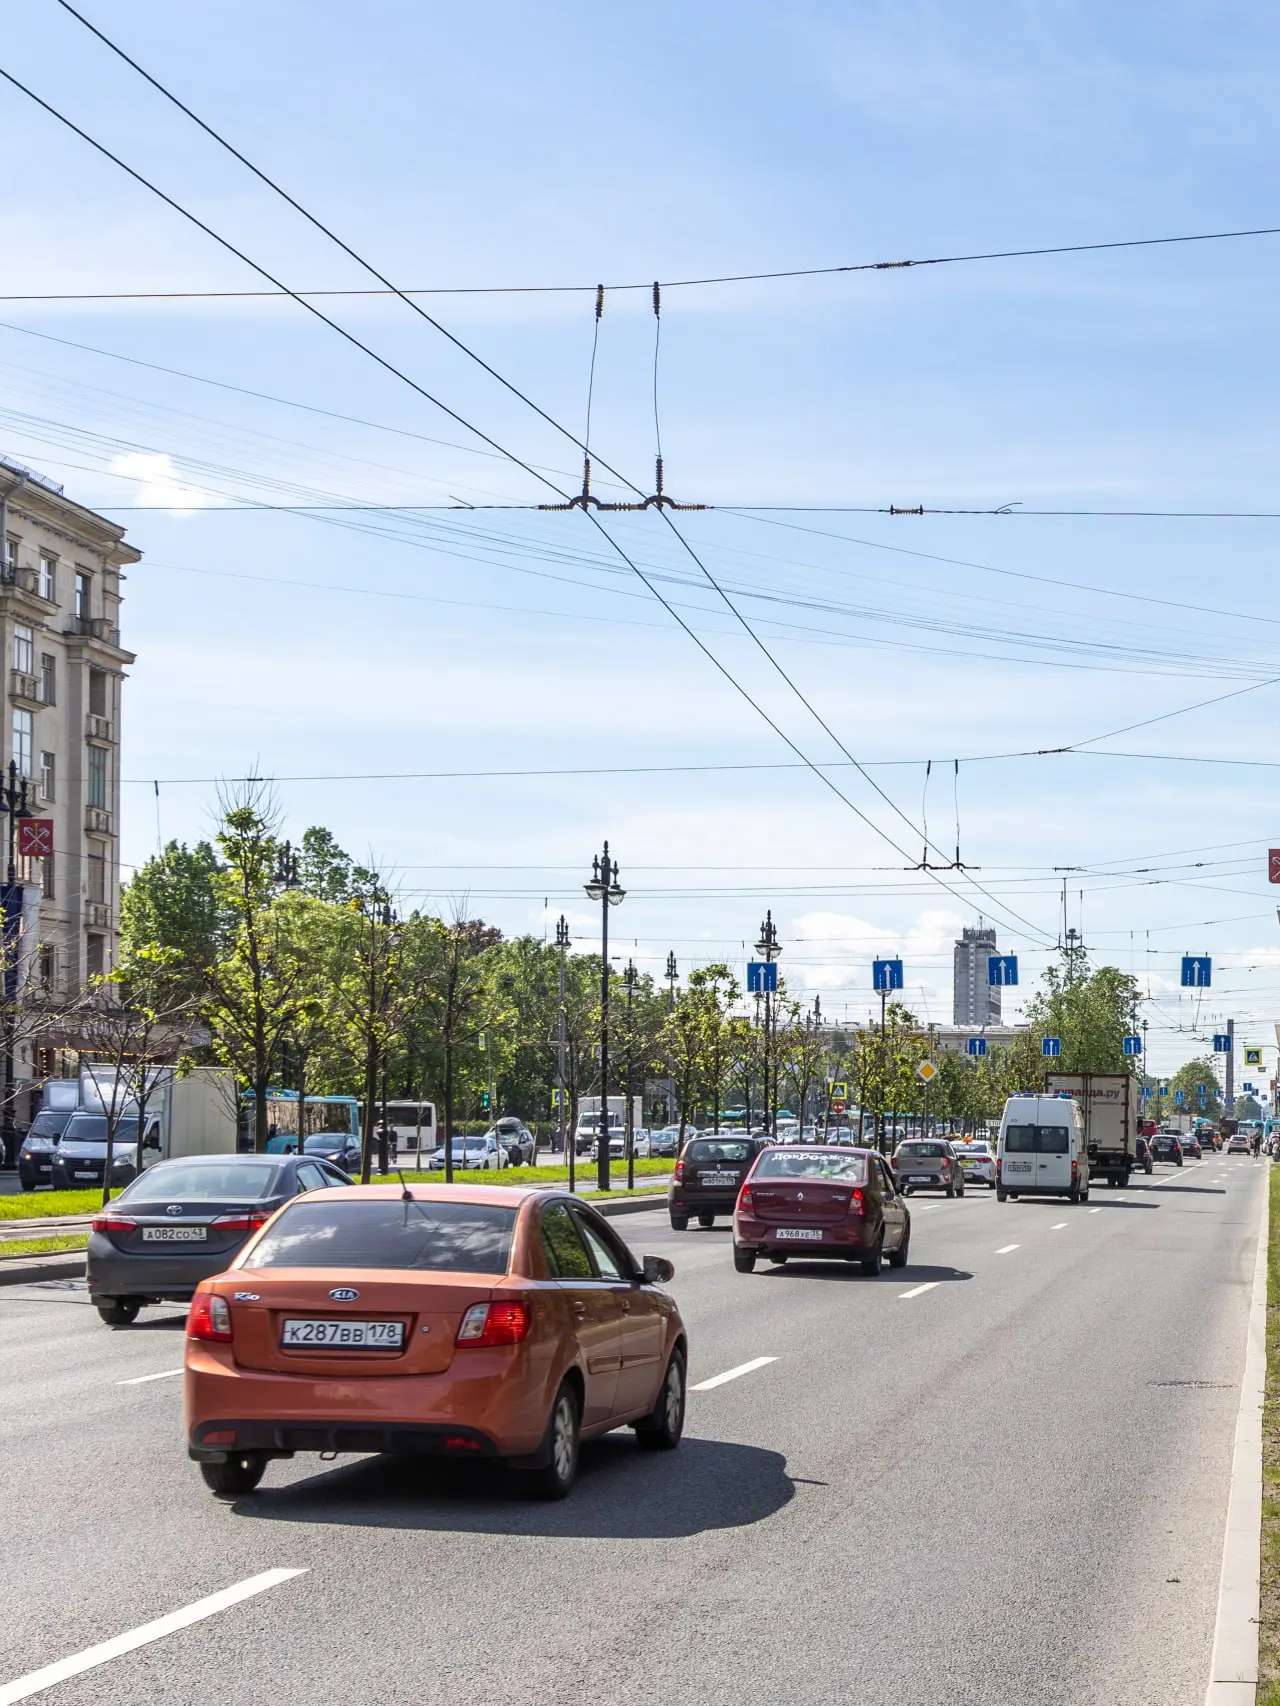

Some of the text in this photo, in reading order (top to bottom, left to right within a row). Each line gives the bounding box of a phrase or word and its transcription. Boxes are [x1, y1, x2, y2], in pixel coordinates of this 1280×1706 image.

[191, 1229, 203, 1237] 43
[333, 1290, 355, 1299] KIA
[368, 1324, 397, 1339] 178
